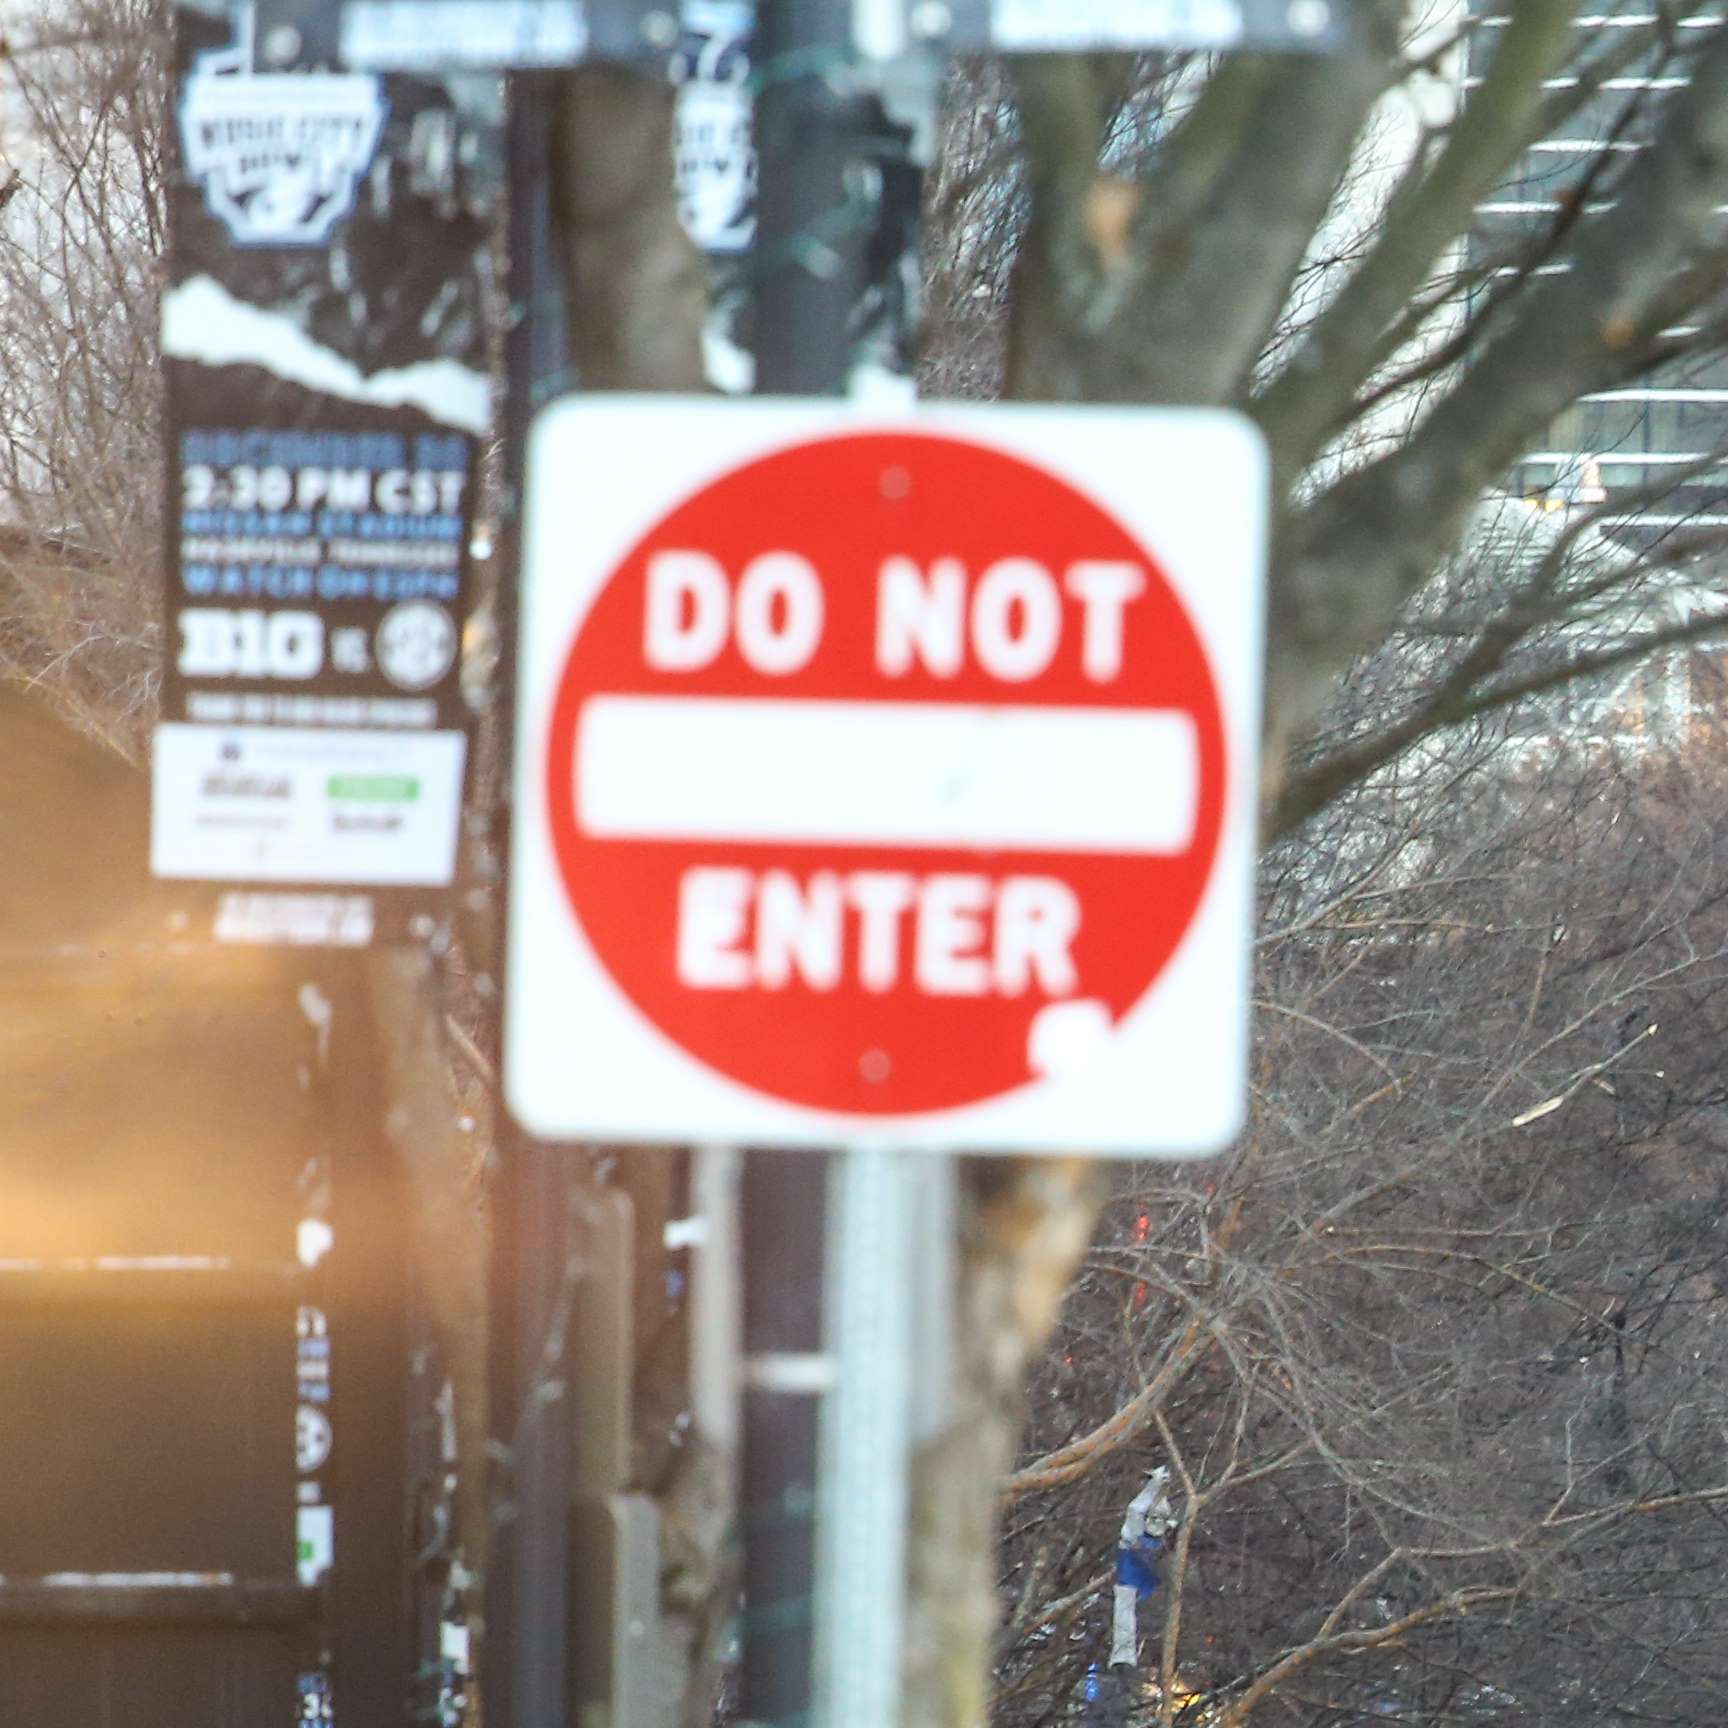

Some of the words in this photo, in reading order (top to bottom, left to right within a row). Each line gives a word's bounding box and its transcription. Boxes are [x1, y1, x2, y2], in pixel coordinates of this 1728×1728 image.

[296, 467, 372, 512] PM
[376, 469, 466, 514] CST
[642, 549, 825, 676] DO
[873, 555, 1146, 685] NOT
[674, 865, 1084, 1000] ENTER
